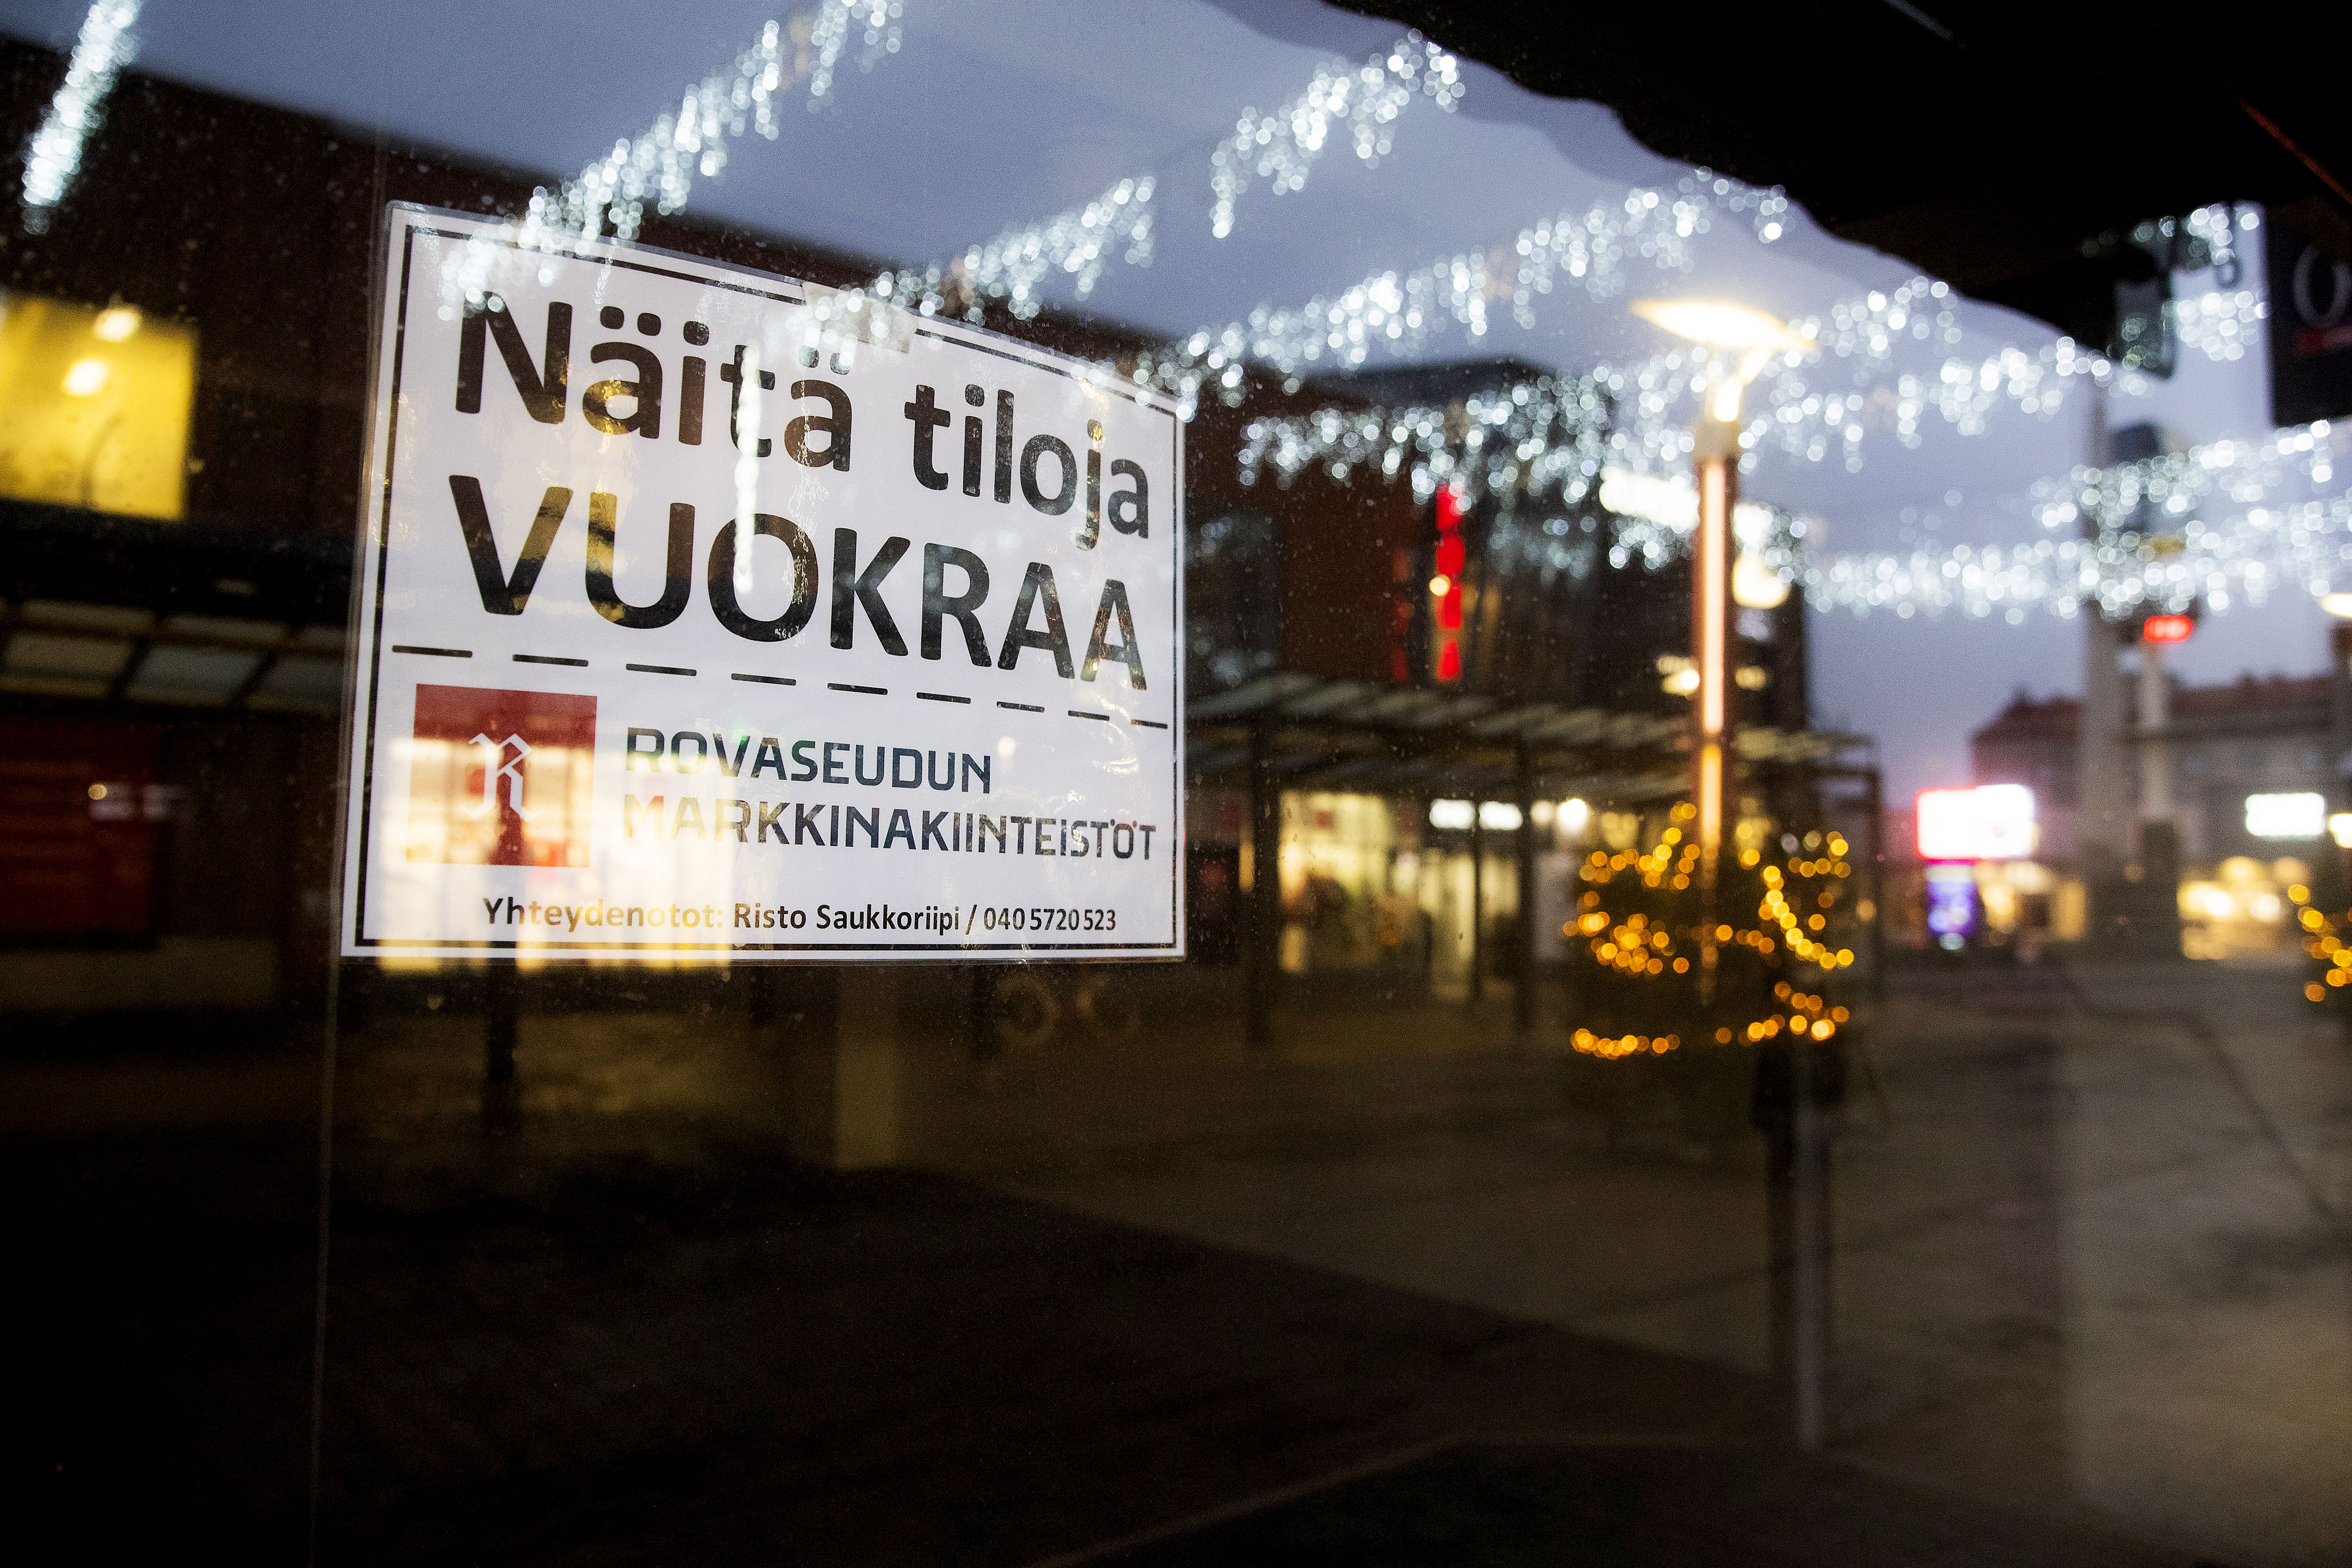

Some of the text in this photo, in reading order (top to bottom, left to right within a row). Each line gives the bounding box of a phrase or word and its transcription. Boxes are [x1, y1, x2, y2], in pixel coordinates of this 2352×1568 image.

[455, 290, 1149, 551] Näitä tiloja
[449, 475, 1147, 691] VUOKRAA
[625, 726, 991, 794] ROVASEUDUN
[624, 793, 1156, 860] MARKKINAKIINTEISTÖT
[482, 897, 723, 932] Yhteydenotot:
[734, 902, 807, 929] Risto
[816, 904, 959, 936] Saukkoriipi
